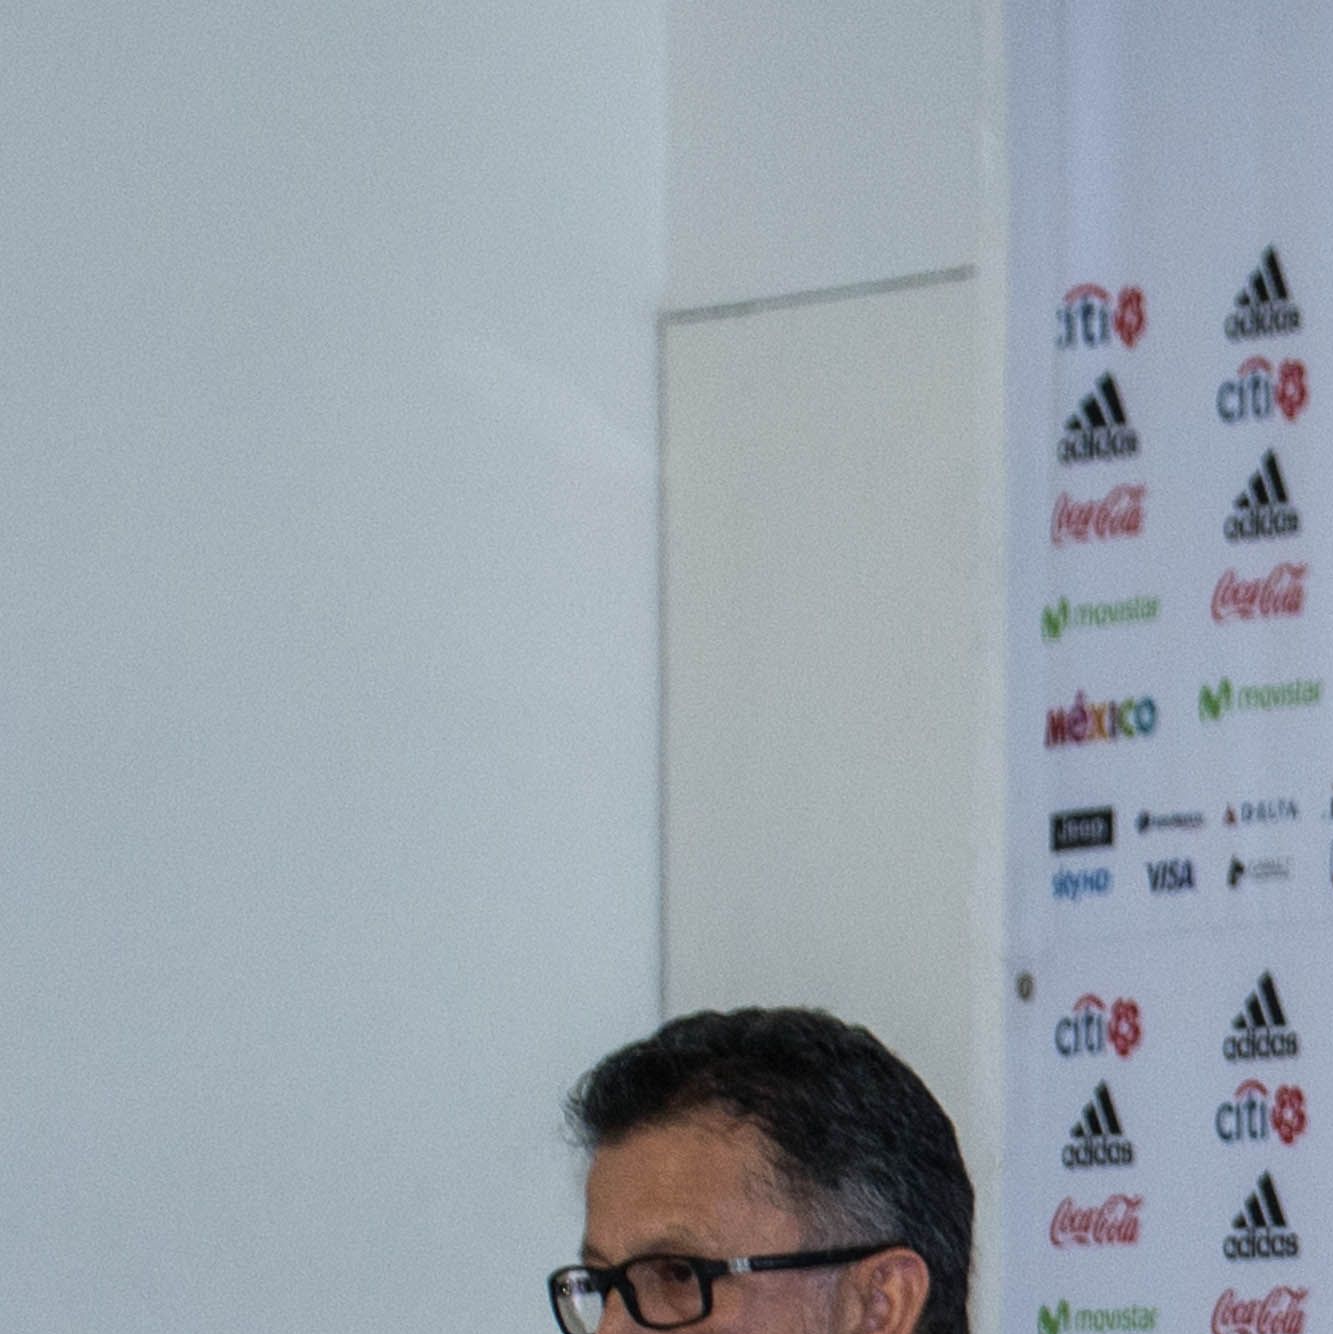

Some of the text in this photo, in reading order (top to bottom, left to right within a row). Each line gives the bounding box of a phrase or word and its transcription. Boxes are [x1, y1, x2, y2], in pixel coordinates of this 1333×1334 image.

[1225, 303, 1301, 341] adidas
[1058, 432, 1139, 465] adidas
[1224, 505, 1301, 542] adidas
[1147, 859, 1196, 892] VISA
[1055, 1010, 1106, 1058] citi
[1223, 1029, 1300, 1063] adidas
[1215, 1096, 1269, 1144] citi
[1062, 1136, 1135, 1170] adidas
[1223, 1230, 1300, 1261] adidas
[1072, 1304, 1158, 1334] movistar
